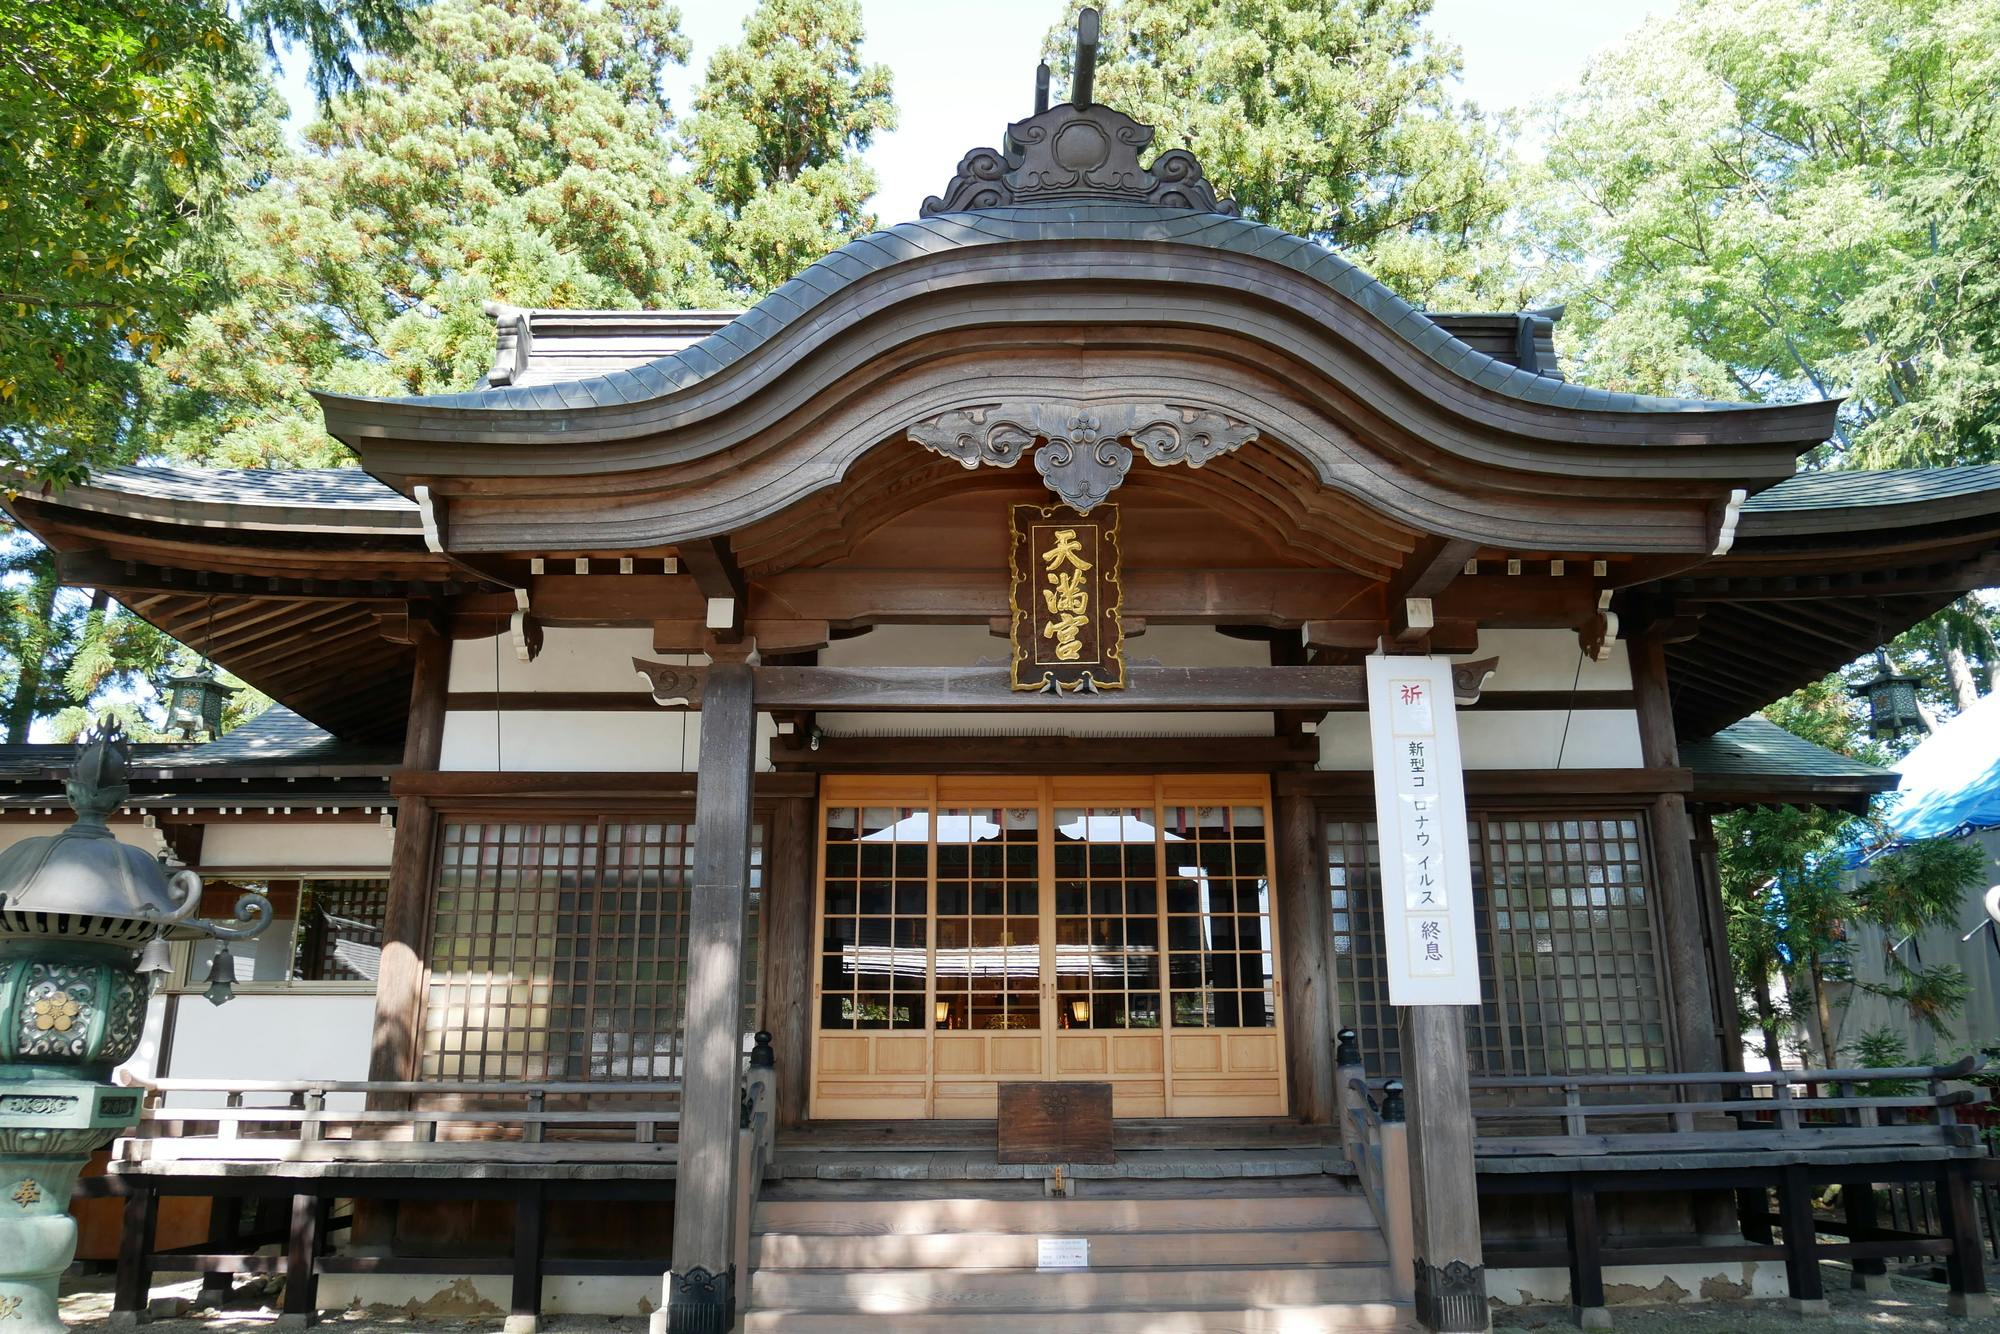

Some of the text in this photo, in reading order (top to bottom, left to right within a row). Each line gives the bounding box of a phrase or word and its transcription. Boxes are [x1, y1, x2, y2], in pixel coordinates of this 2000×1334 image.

[1043, 529, 1093, 660] 天満宮
[1401, 684, 1423, 706] 祈
